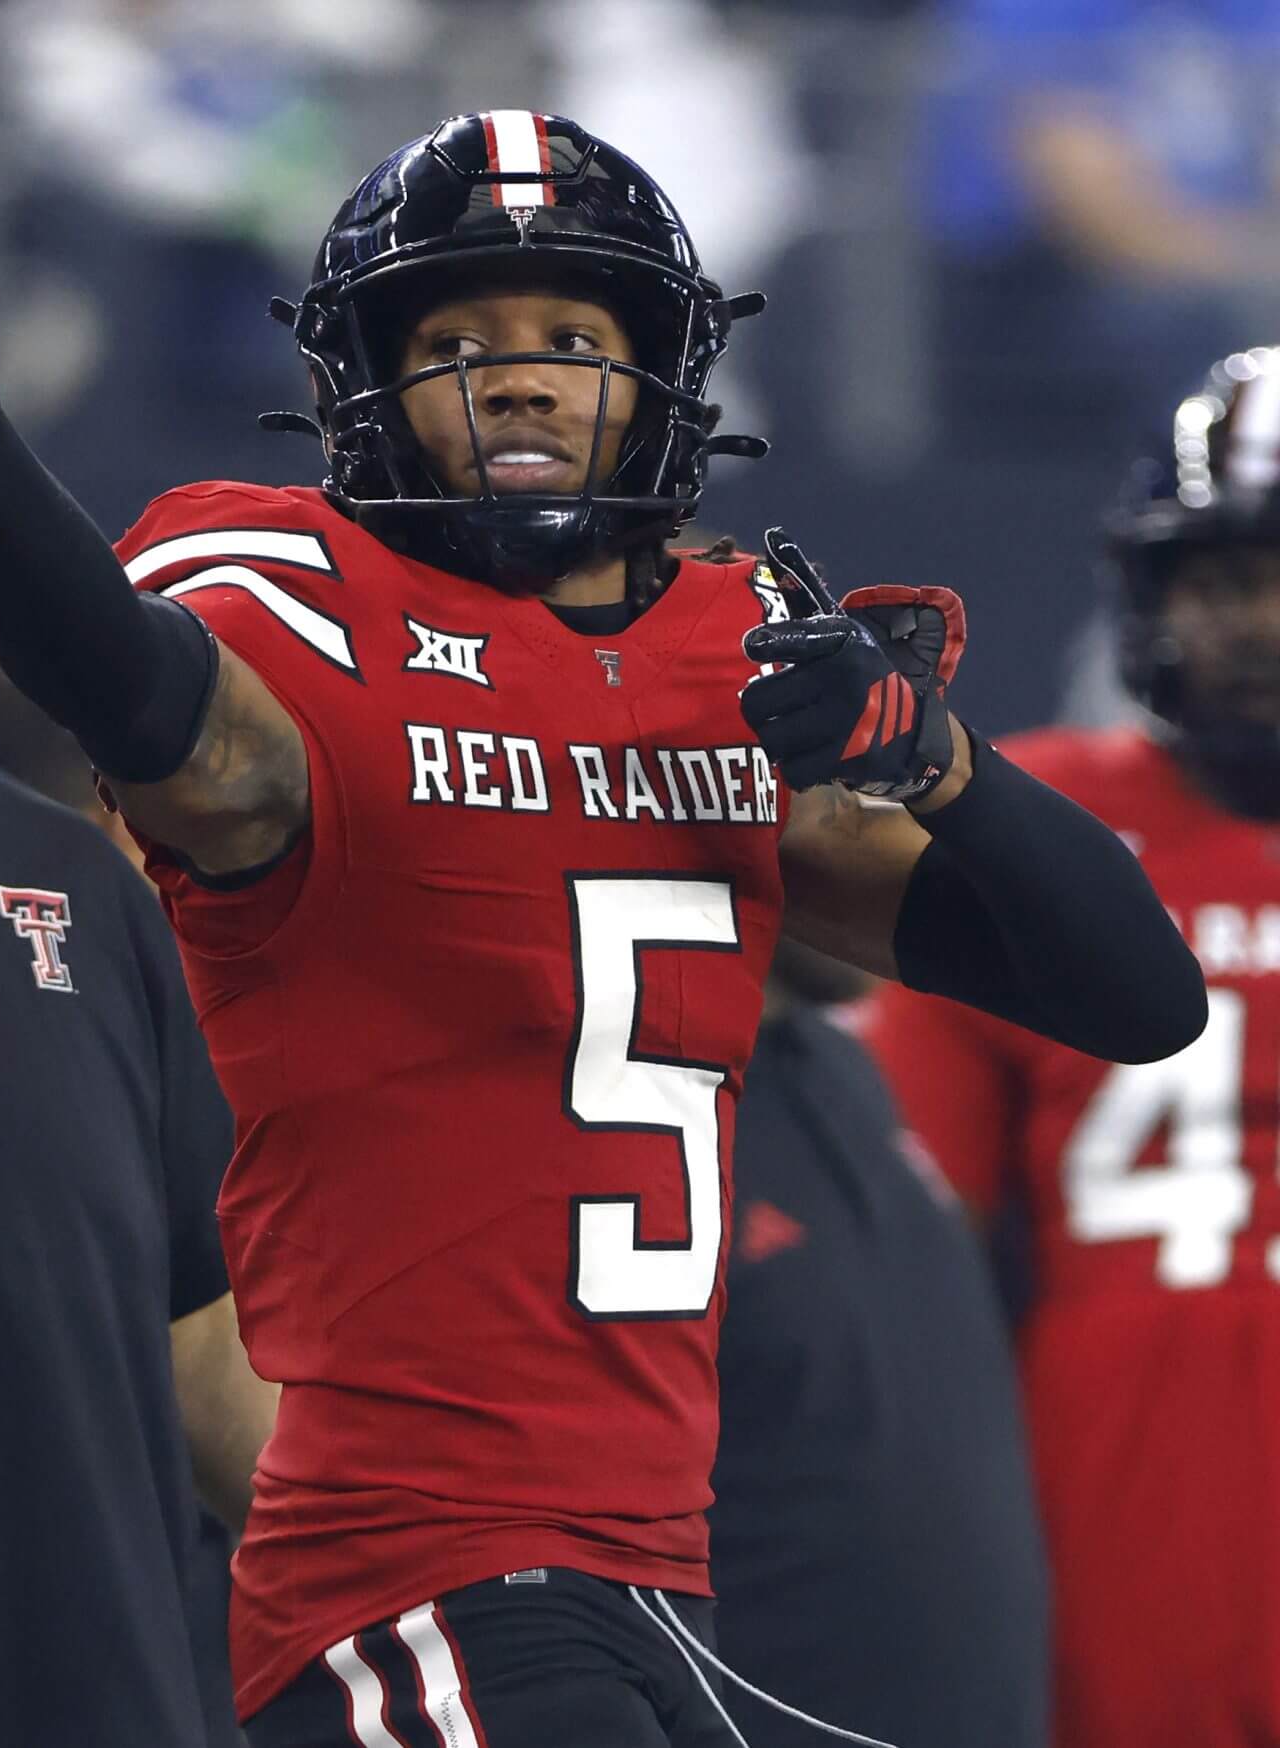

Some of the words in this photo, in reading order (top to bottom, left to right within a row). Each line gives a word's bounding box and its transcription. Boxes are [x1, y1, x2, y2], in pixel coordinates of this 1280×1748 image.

[406, 615, 492, 688] XII
[406, 724, 550, 812] RED
[568, 876, 740, 1316] 5
[1060, 986, 1280, 1288] 4
